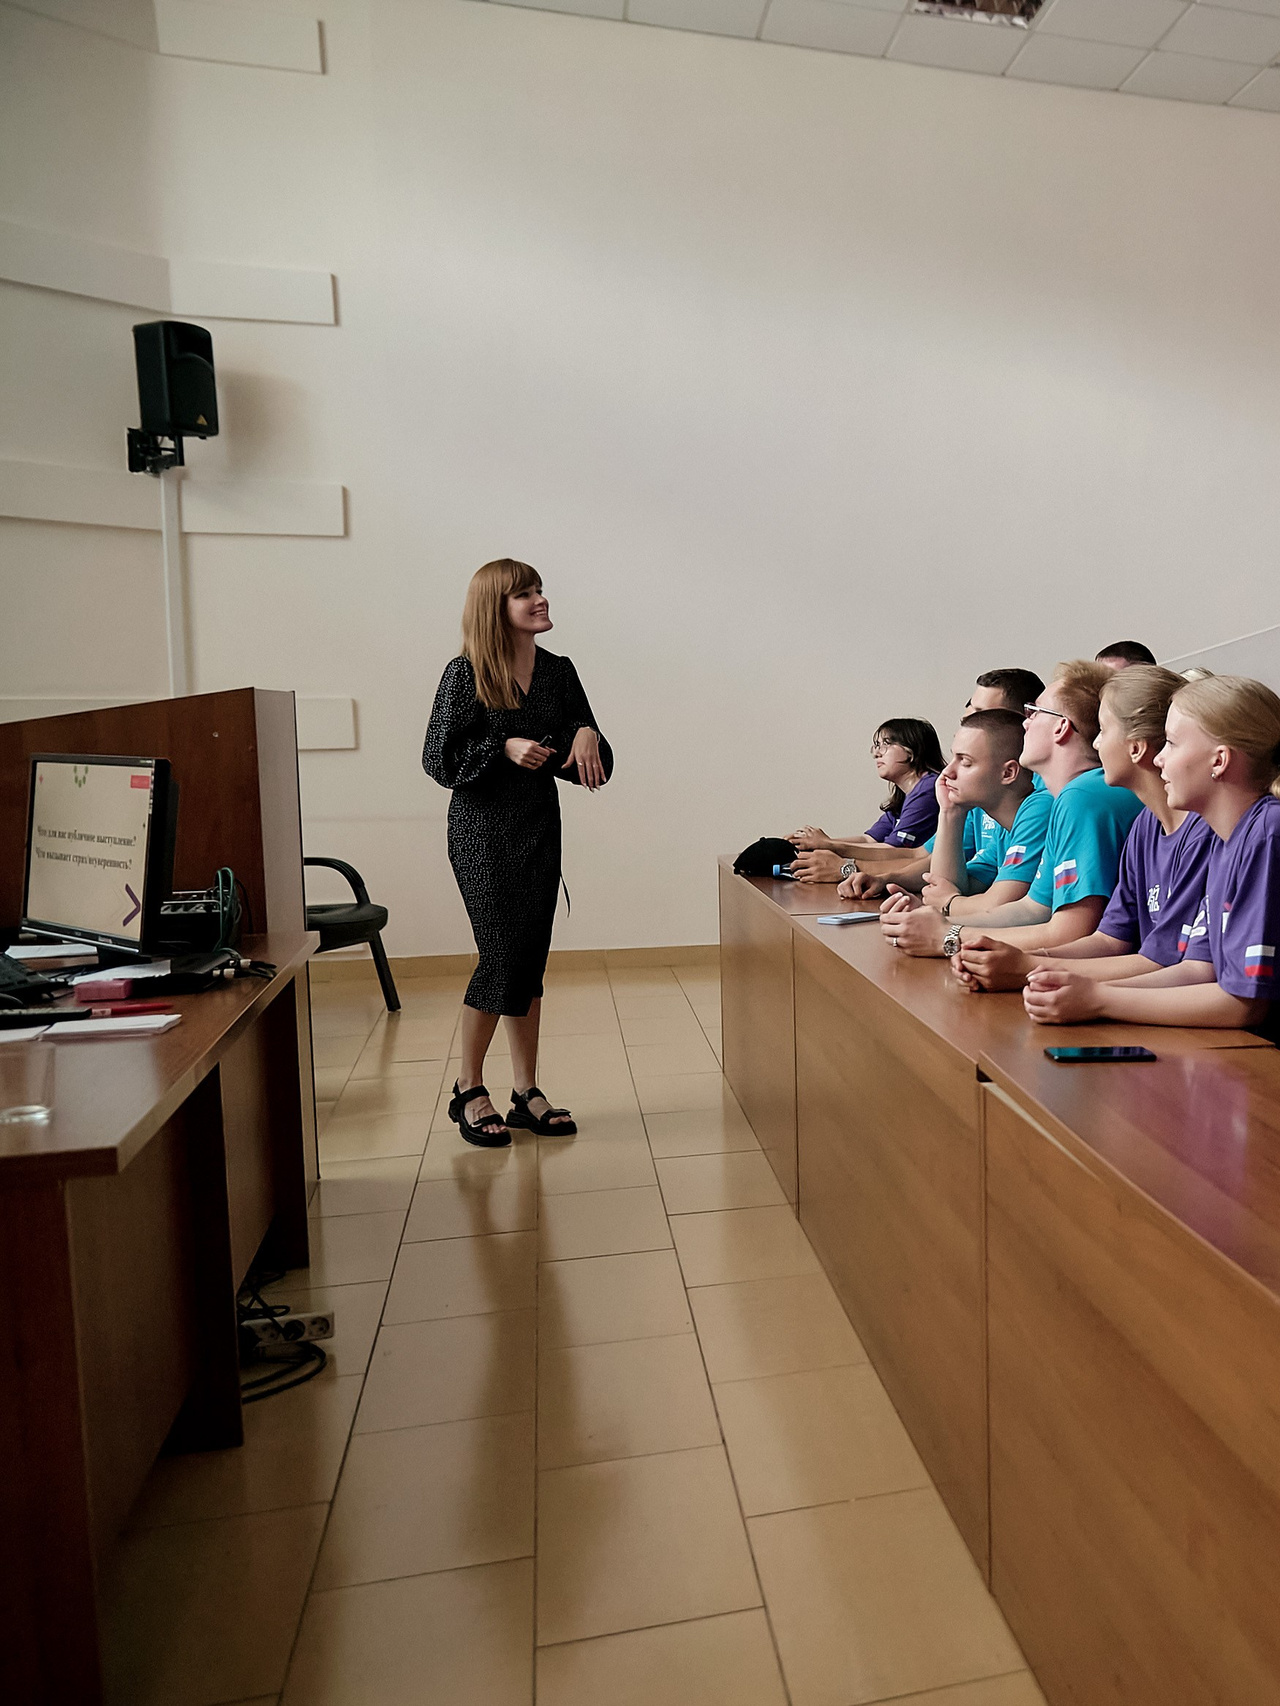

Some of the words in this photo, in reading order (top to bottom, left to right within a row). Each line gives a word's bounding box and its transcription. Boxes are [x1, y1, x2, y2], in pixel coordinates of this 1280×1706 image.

[37, 826, 47, 837] Что
[48, 829, 57, 838] для
[58, 830, 67, 839] вас
[35, 846, 45, 858] Что
[46, 851, 72, 862] вызывает
